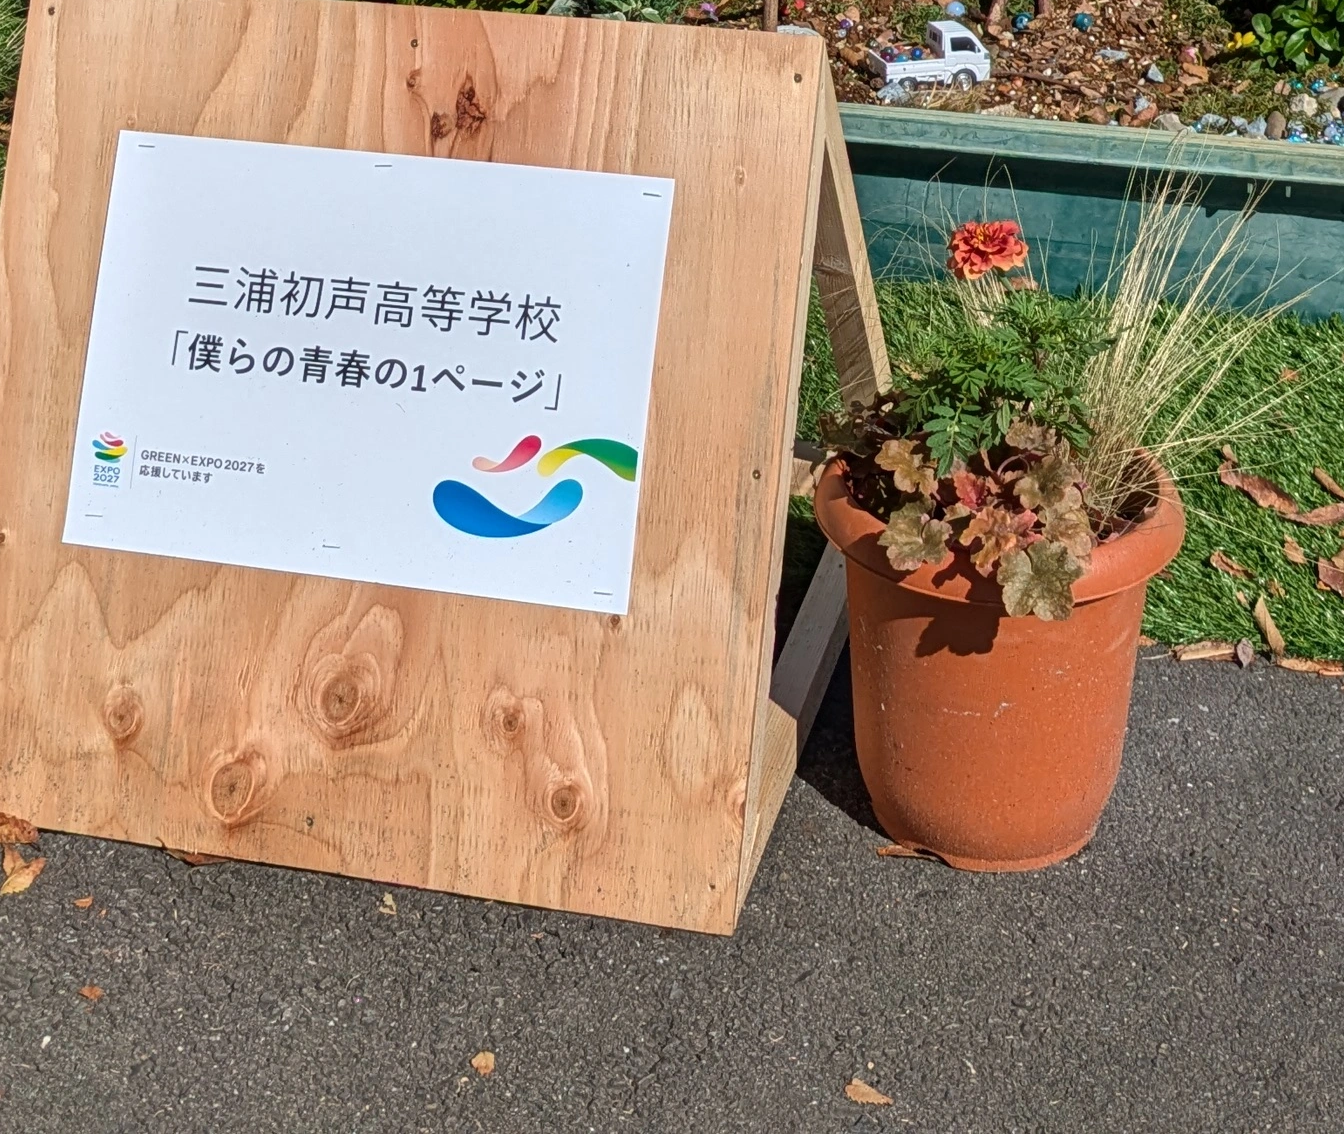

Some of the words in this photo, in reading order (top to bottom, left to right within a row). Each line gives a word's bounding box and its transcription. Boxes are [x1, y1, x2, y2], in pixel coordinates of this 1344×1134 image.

[187, 265, 563, 344] 三浦初声高等学校
[170, 329, 562, 411] 「僕らの青春の1ページ」
[93, 473, 120, 483] 2027
[94, 465, 121, 475] EXPO
[139, 464, 213, 483] 応援しています
